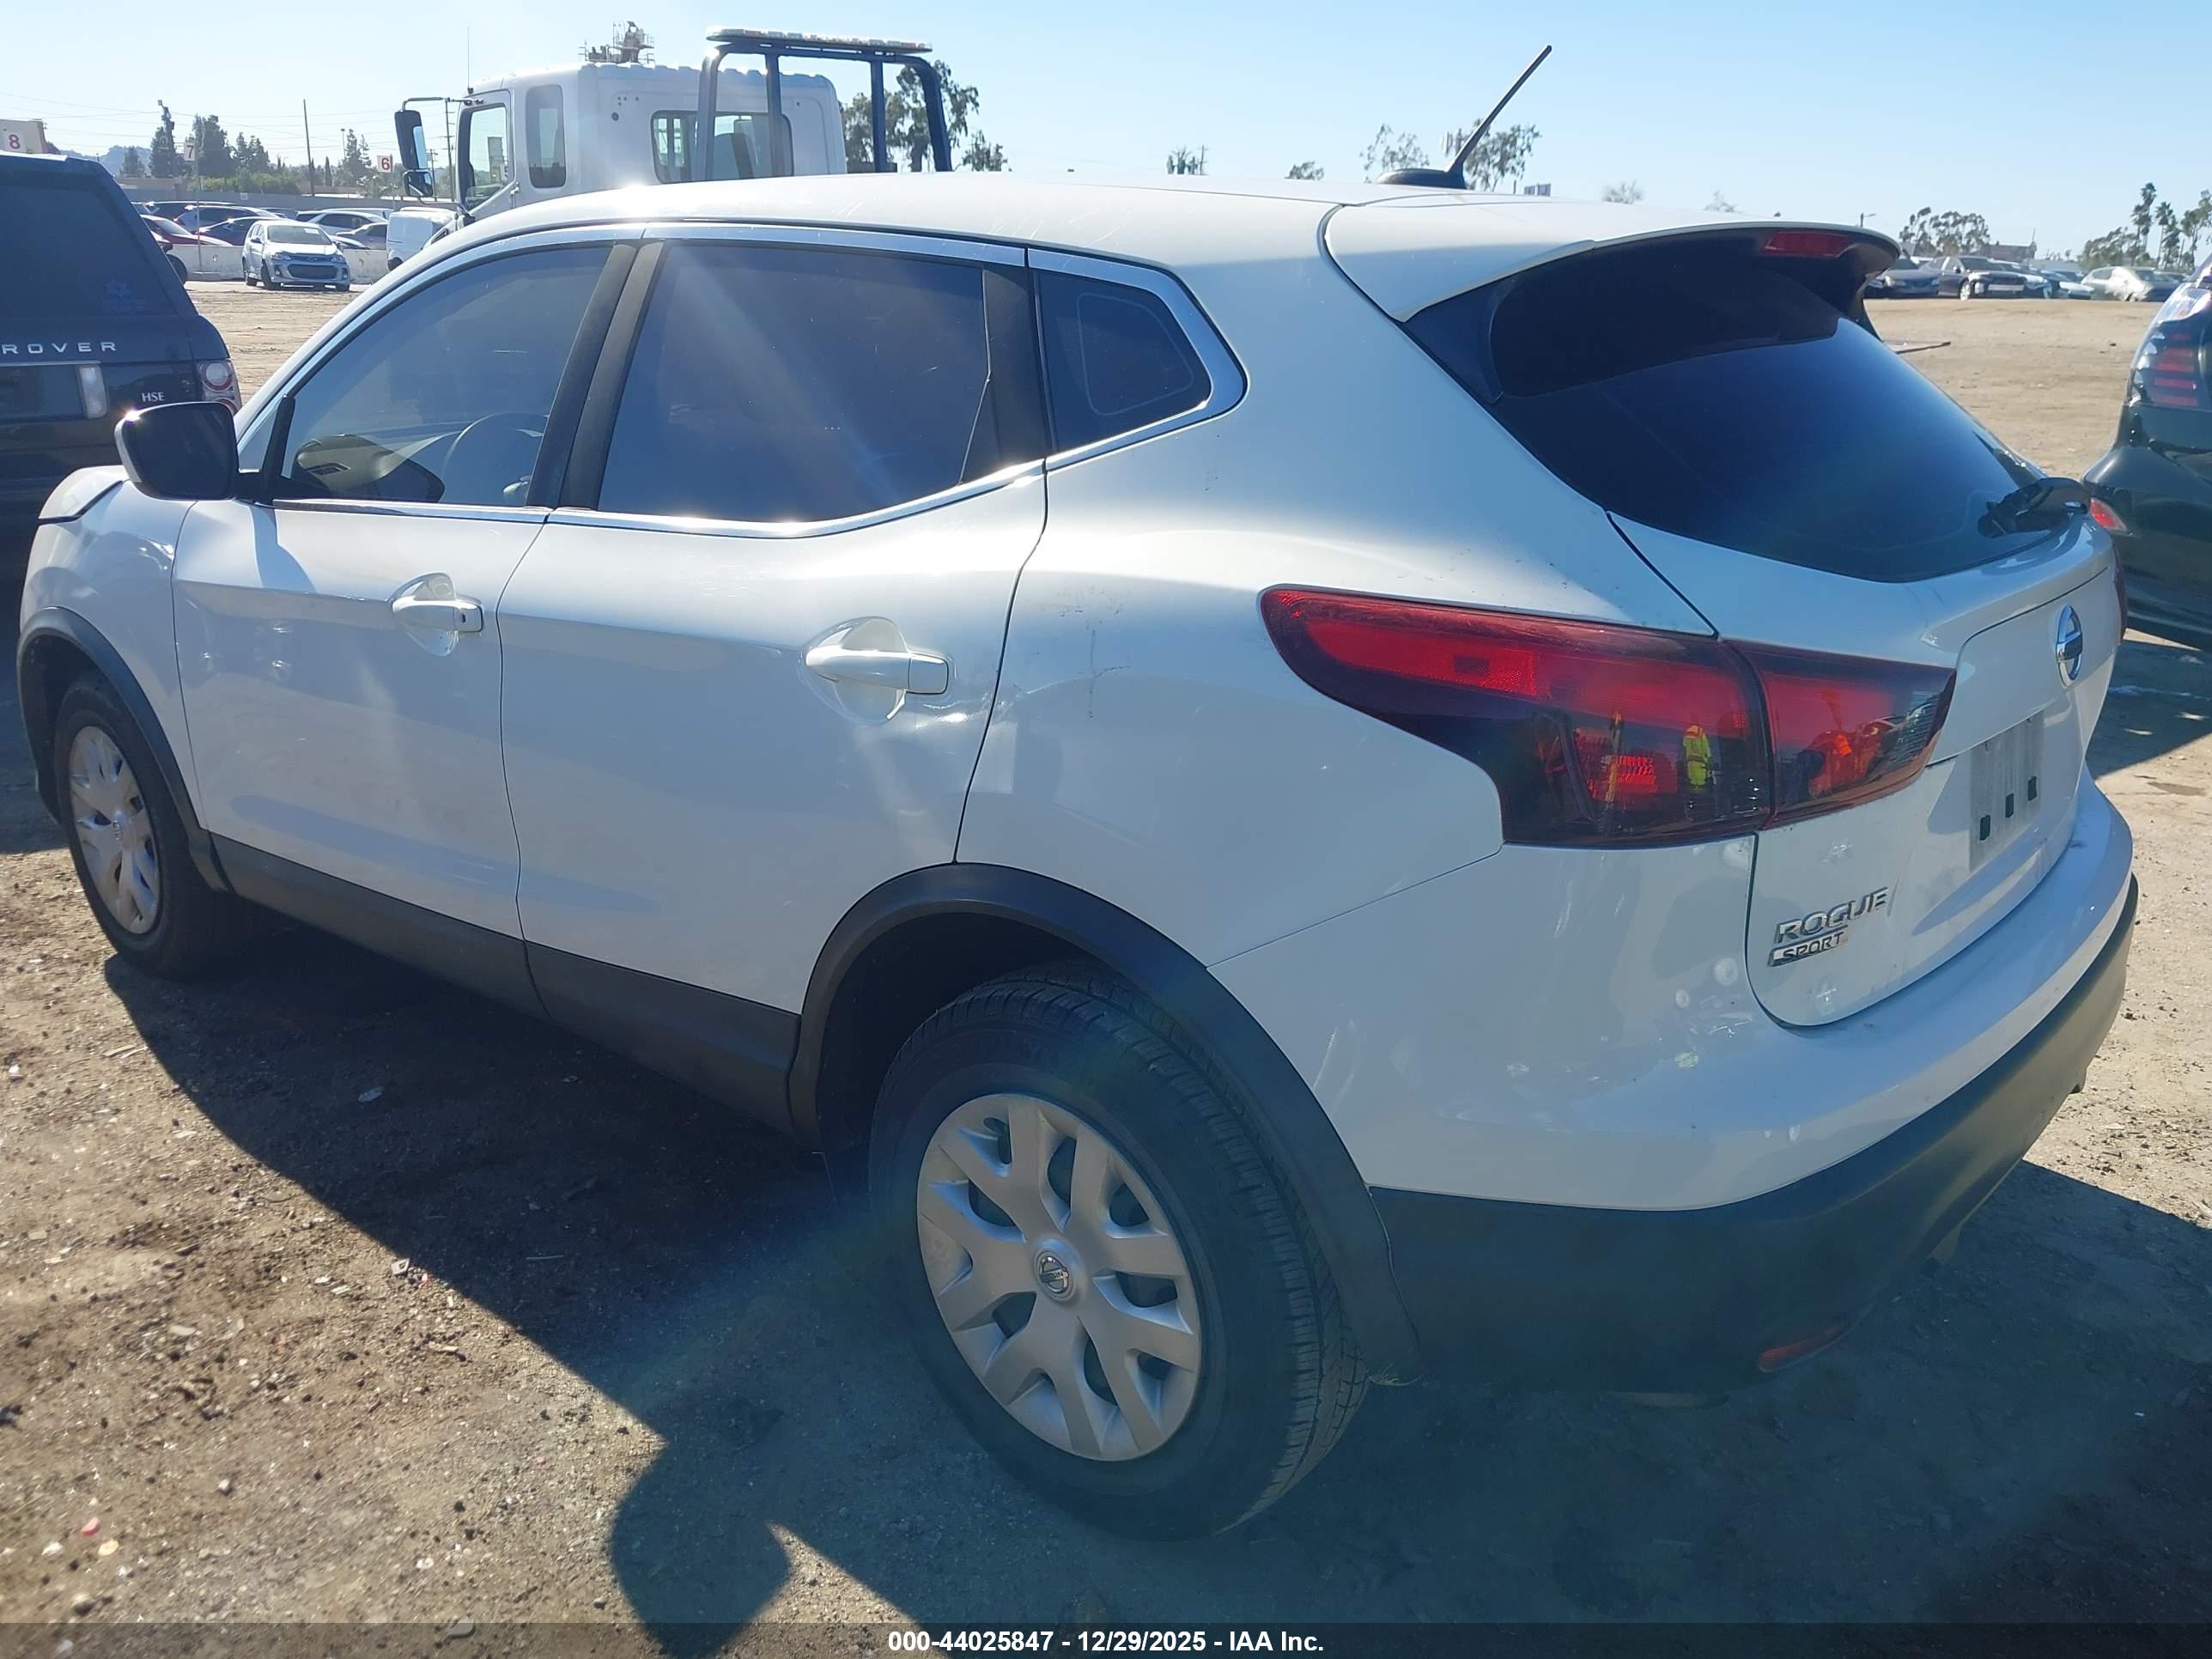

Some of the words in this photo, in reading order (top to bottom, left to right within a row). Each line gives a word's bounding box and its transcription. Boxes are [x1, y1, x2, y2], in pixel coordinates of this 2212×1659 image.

[9, 134, 21, 149] 8
[186, 145, 195, 159] 7
[381, 157, 391, 170] 6
[2, 341, 117, 355] ROVER
[142, 392, 166, 403] HSE
[1774, 886, 1889, 945] ROGUE
[1782, 931, 1845, 959] SPORT
